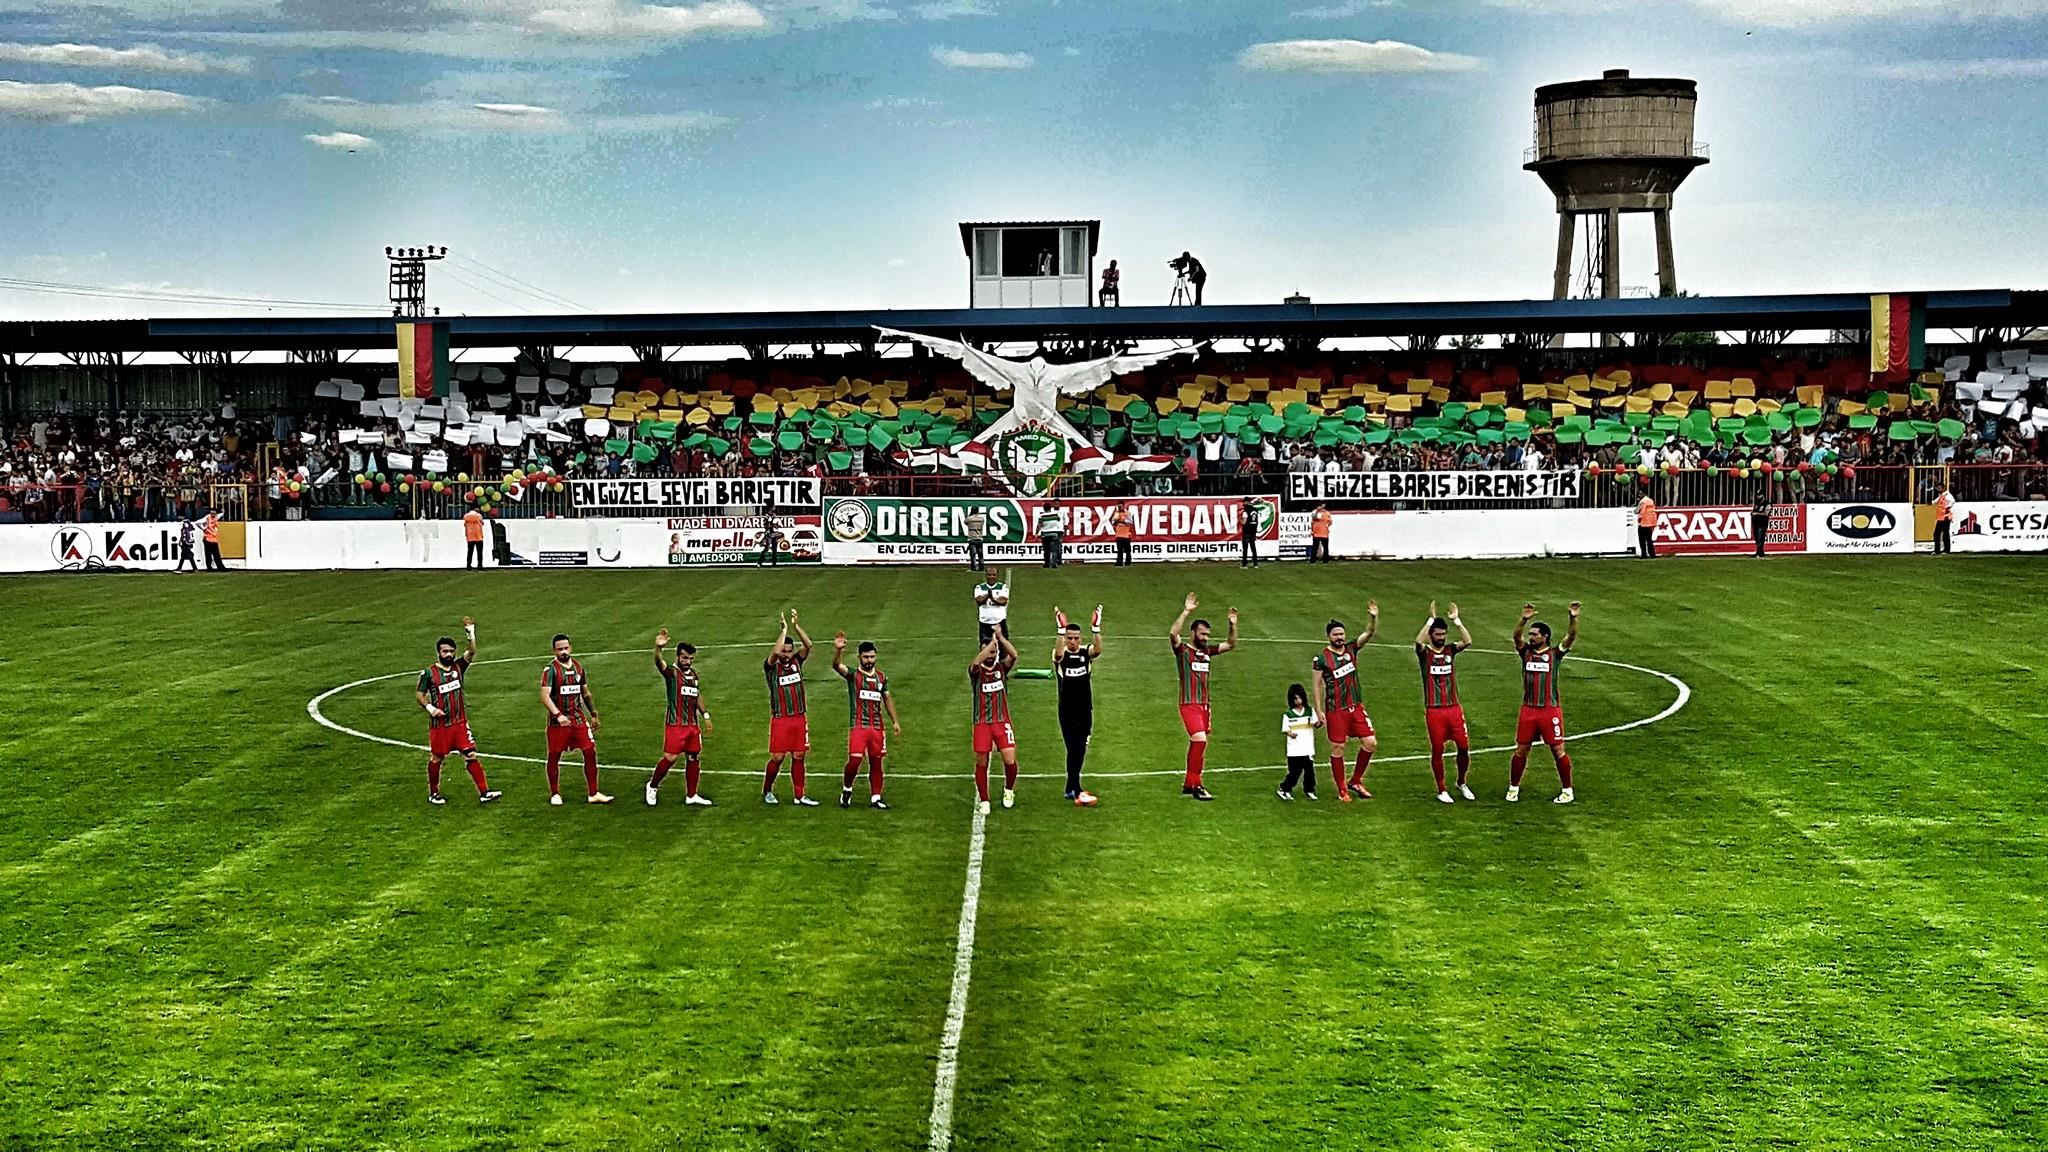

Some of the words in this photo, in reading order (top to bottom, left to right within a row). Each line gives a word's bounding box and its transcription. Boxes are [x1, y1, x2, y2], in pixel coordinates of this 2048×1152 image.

[572, 481, 596, 505] EN
[598, 481, 658, 505] GÜZEL
[661, 480, 709, 505] SEVGİ
[715, 480, 816, 507] BARIŞTIR
[1292, 474, 1318, 498] EN
[1323, 473, 1388, 498] GÜZEL
[1389, 473, 1451, 498] BARIŞ
[671, 518, 707, 529] MADE
[710, 518, 723, 529] IN
[686, 531, 754, 552] mapella
[877, 544, 895, 554] EN
[898, 541, 940, 555] GÜZEL
[688, 553, 744, 563] AMEDSPOR
